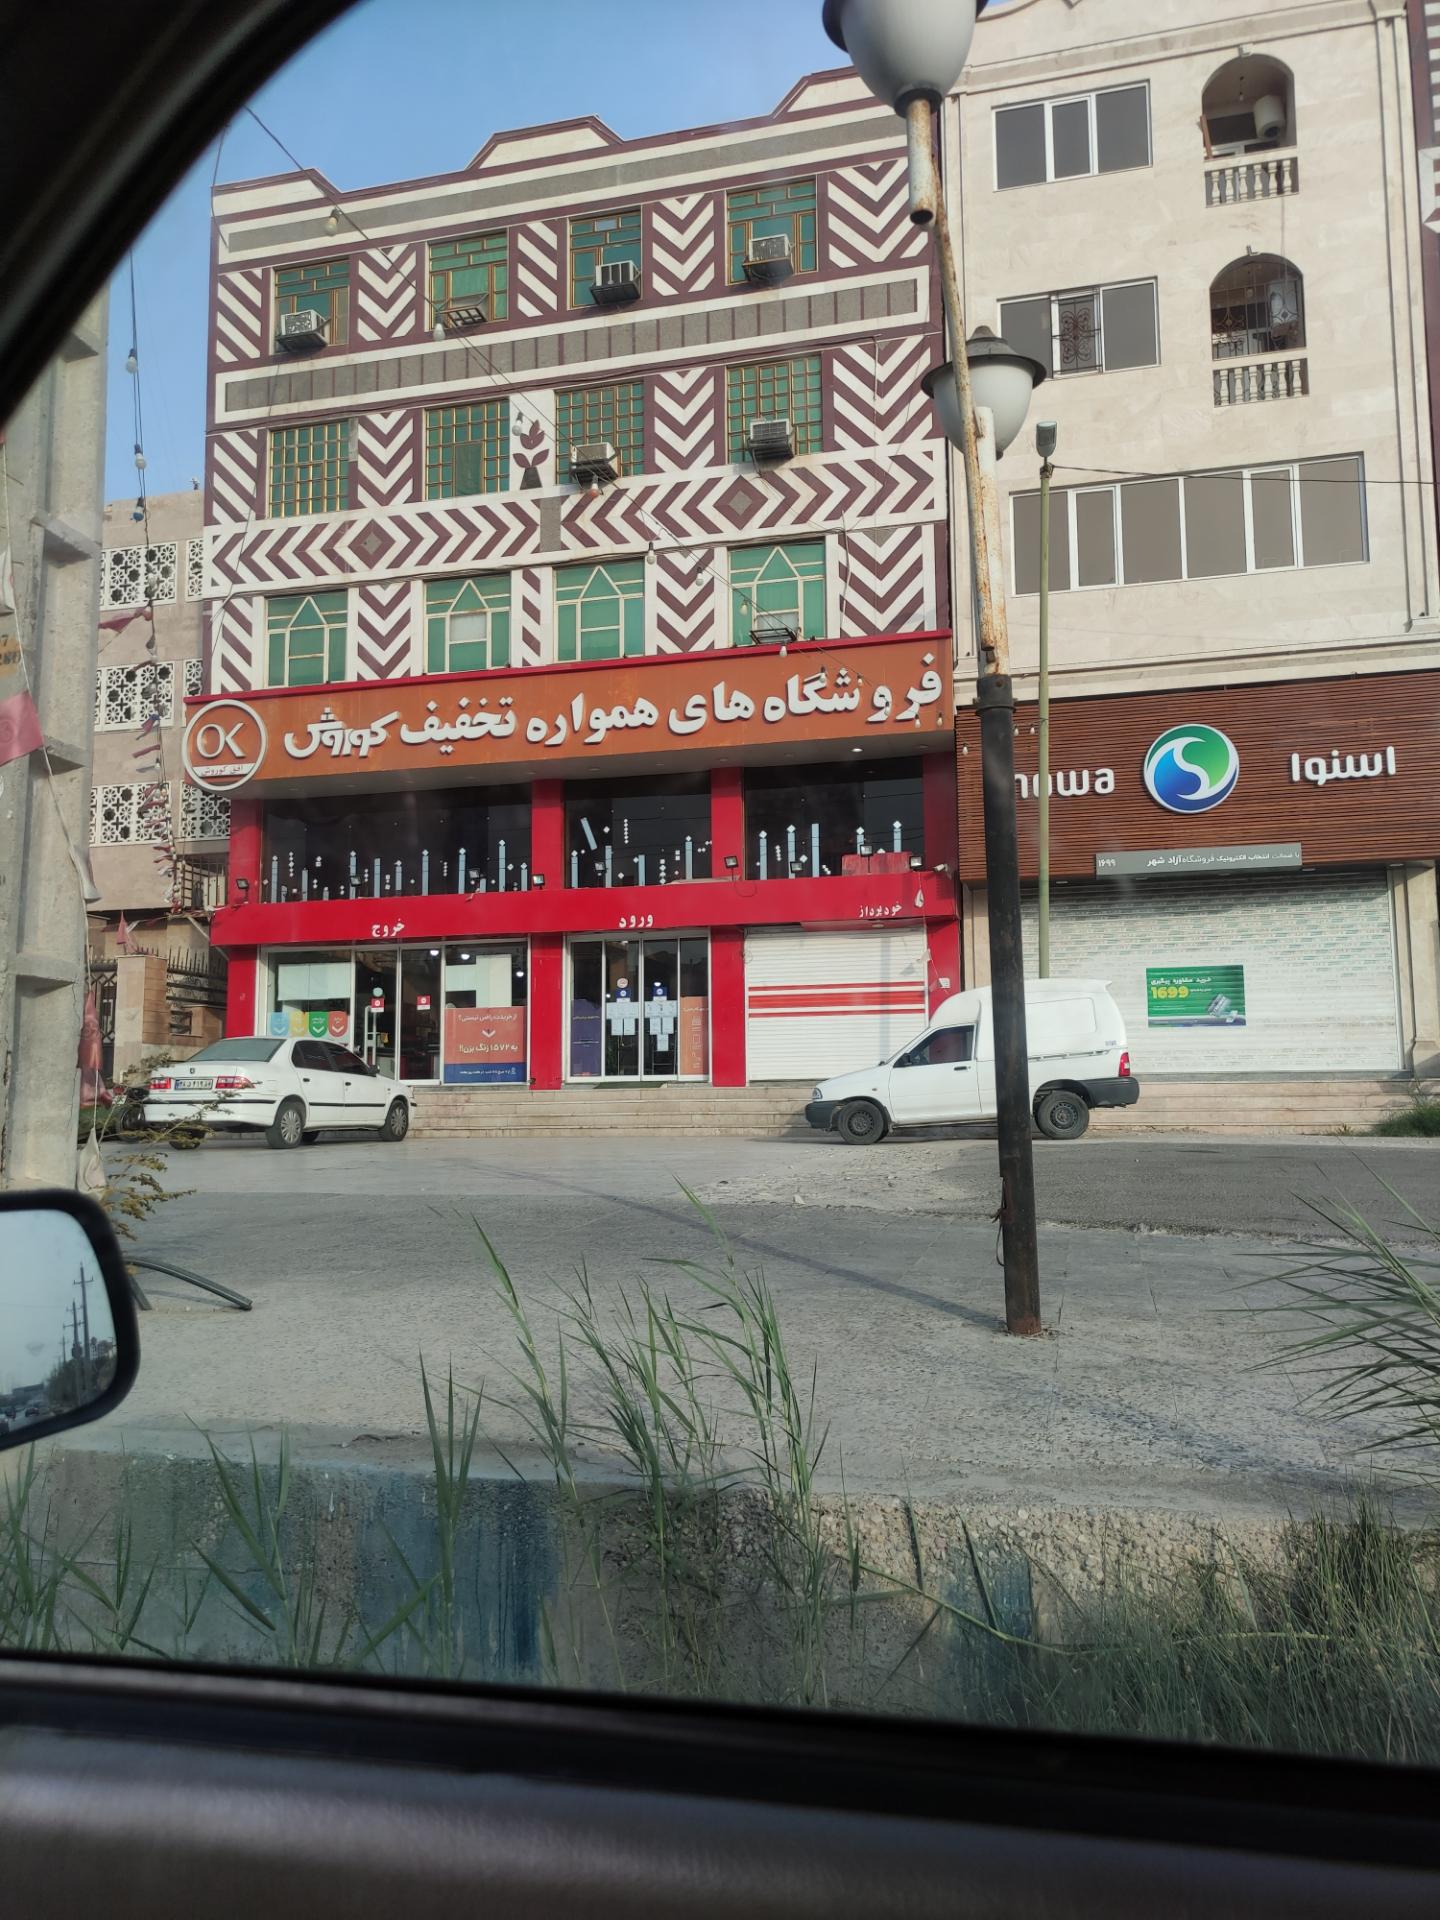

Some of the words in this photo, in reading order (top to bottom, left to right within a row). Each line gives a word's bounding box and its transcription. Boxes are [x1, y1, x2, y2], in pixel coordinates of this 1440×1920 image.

[763, 652, 943, 722] فروشگاه
[526, 691, 660, 747] همواره
[668, 681, 756, 735] های
[197, 722, 246, 759] OK
[284, 706, 400, 758] کوروش
[400, 696, 518, 755] تخفیف
[1290, 746, 1397, 785] اسنوا
[1014, 768, 1115, 799] nowa
[1146, 856, 1165, 867] شهر
[1167, 854, 1182, 866] آزاد
[1182, 854, 1215, 865] فروشگاه
[371, 918, 405, 938] خروج
[618, 913, 654, 929] ورود
[1150, 985, 1190, 1000] 1699
